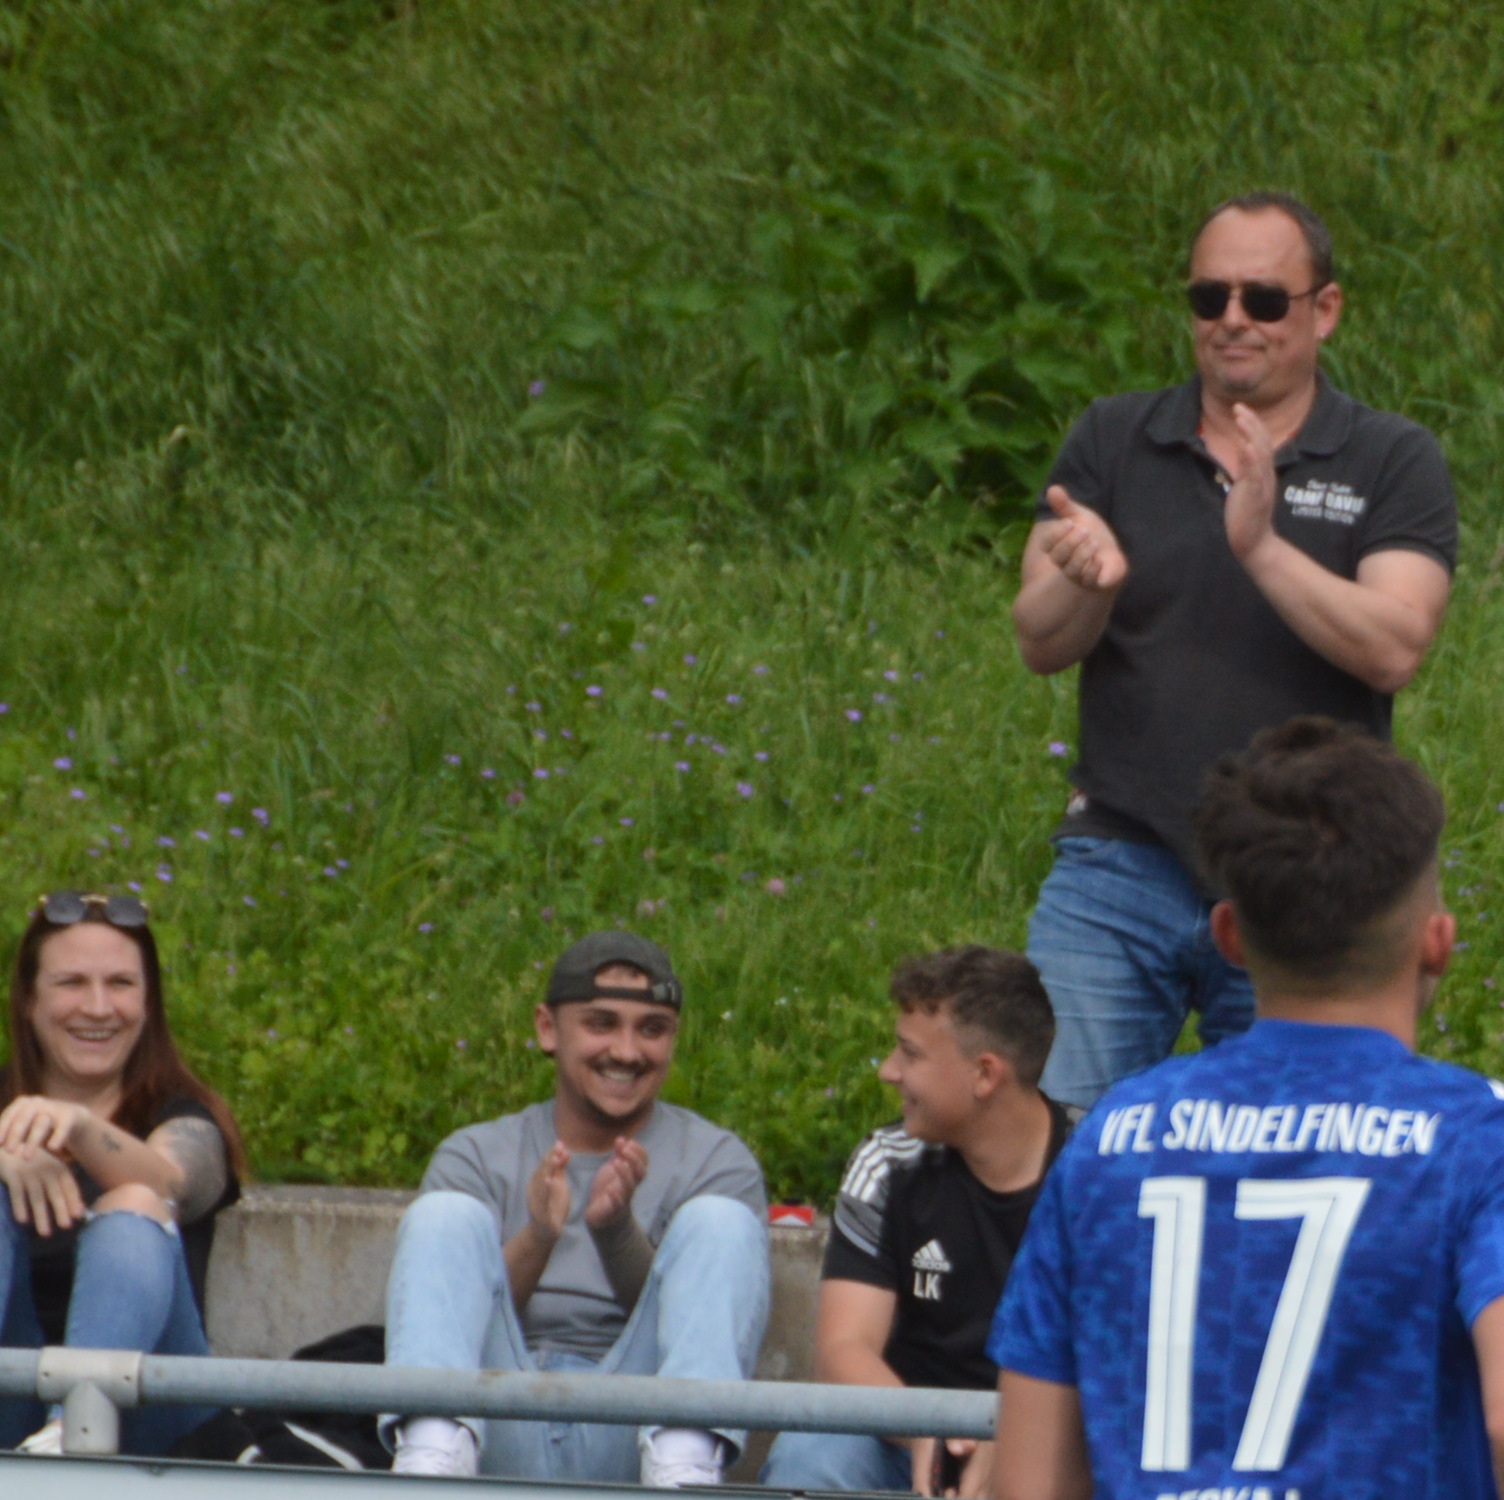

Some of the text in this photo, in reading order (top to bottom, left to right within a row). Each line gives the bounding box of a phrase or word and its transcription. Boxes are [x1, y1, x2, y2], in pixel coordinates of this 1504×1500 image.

[1098, 1098, 1442, 1158] VFL SINDELFINGEN
[913, 1271, 940, 1300] LK
[1137, 1177, 1371, 1472] 17
